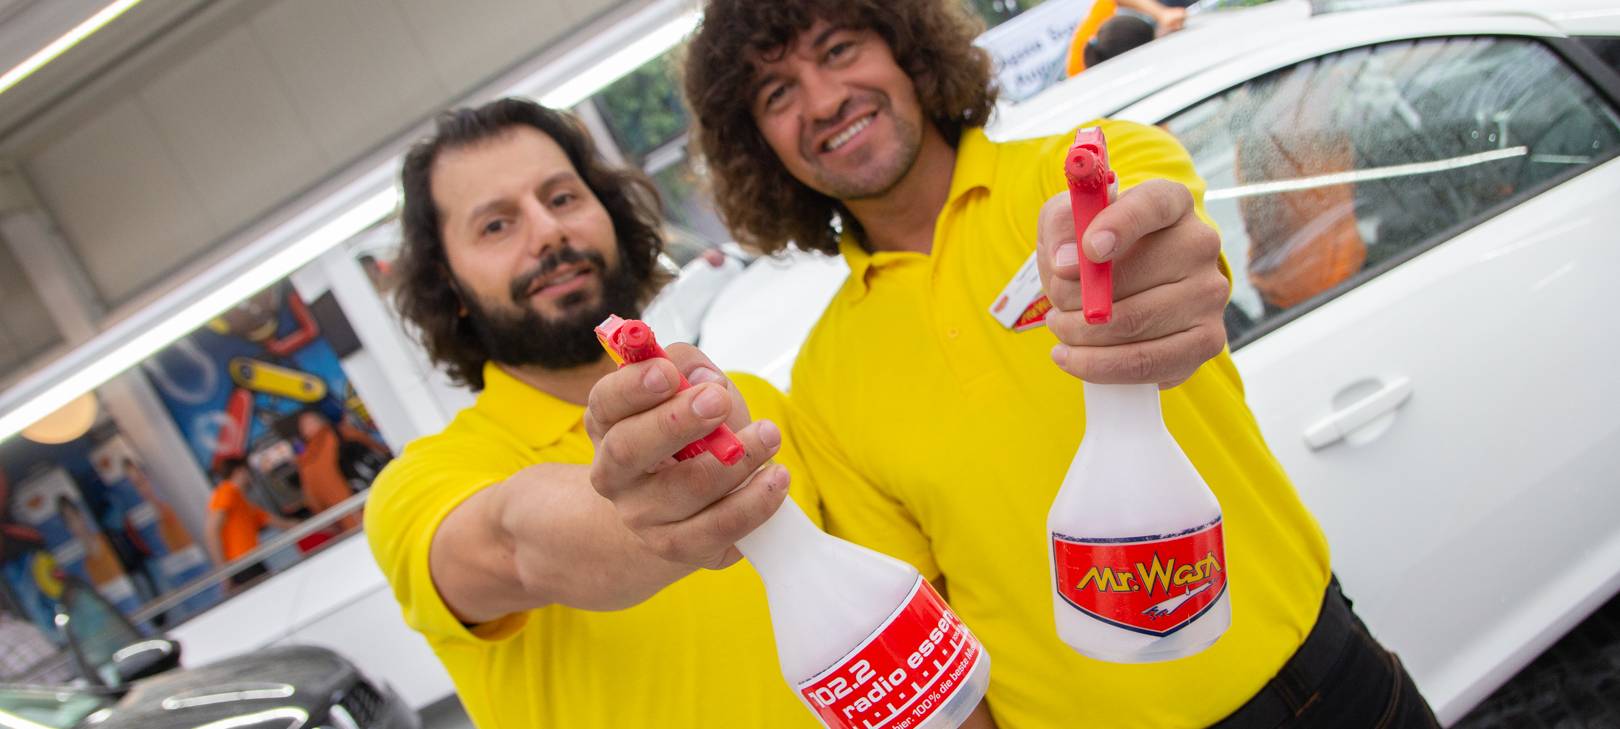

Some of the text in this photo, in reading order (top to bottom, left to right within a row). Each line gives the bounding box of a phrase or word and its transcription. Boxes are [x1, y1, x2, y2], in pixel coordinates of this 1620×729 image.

[1075, 551, 1221, 597] Mr. Wash
[808, 660, 876, 708] 102.2
[842, 610, 955, 719] radio essen
[912, 691, 941, 717] 100%
[940, 679, 953, 694] die
[949, 657, 969, 681] beste
